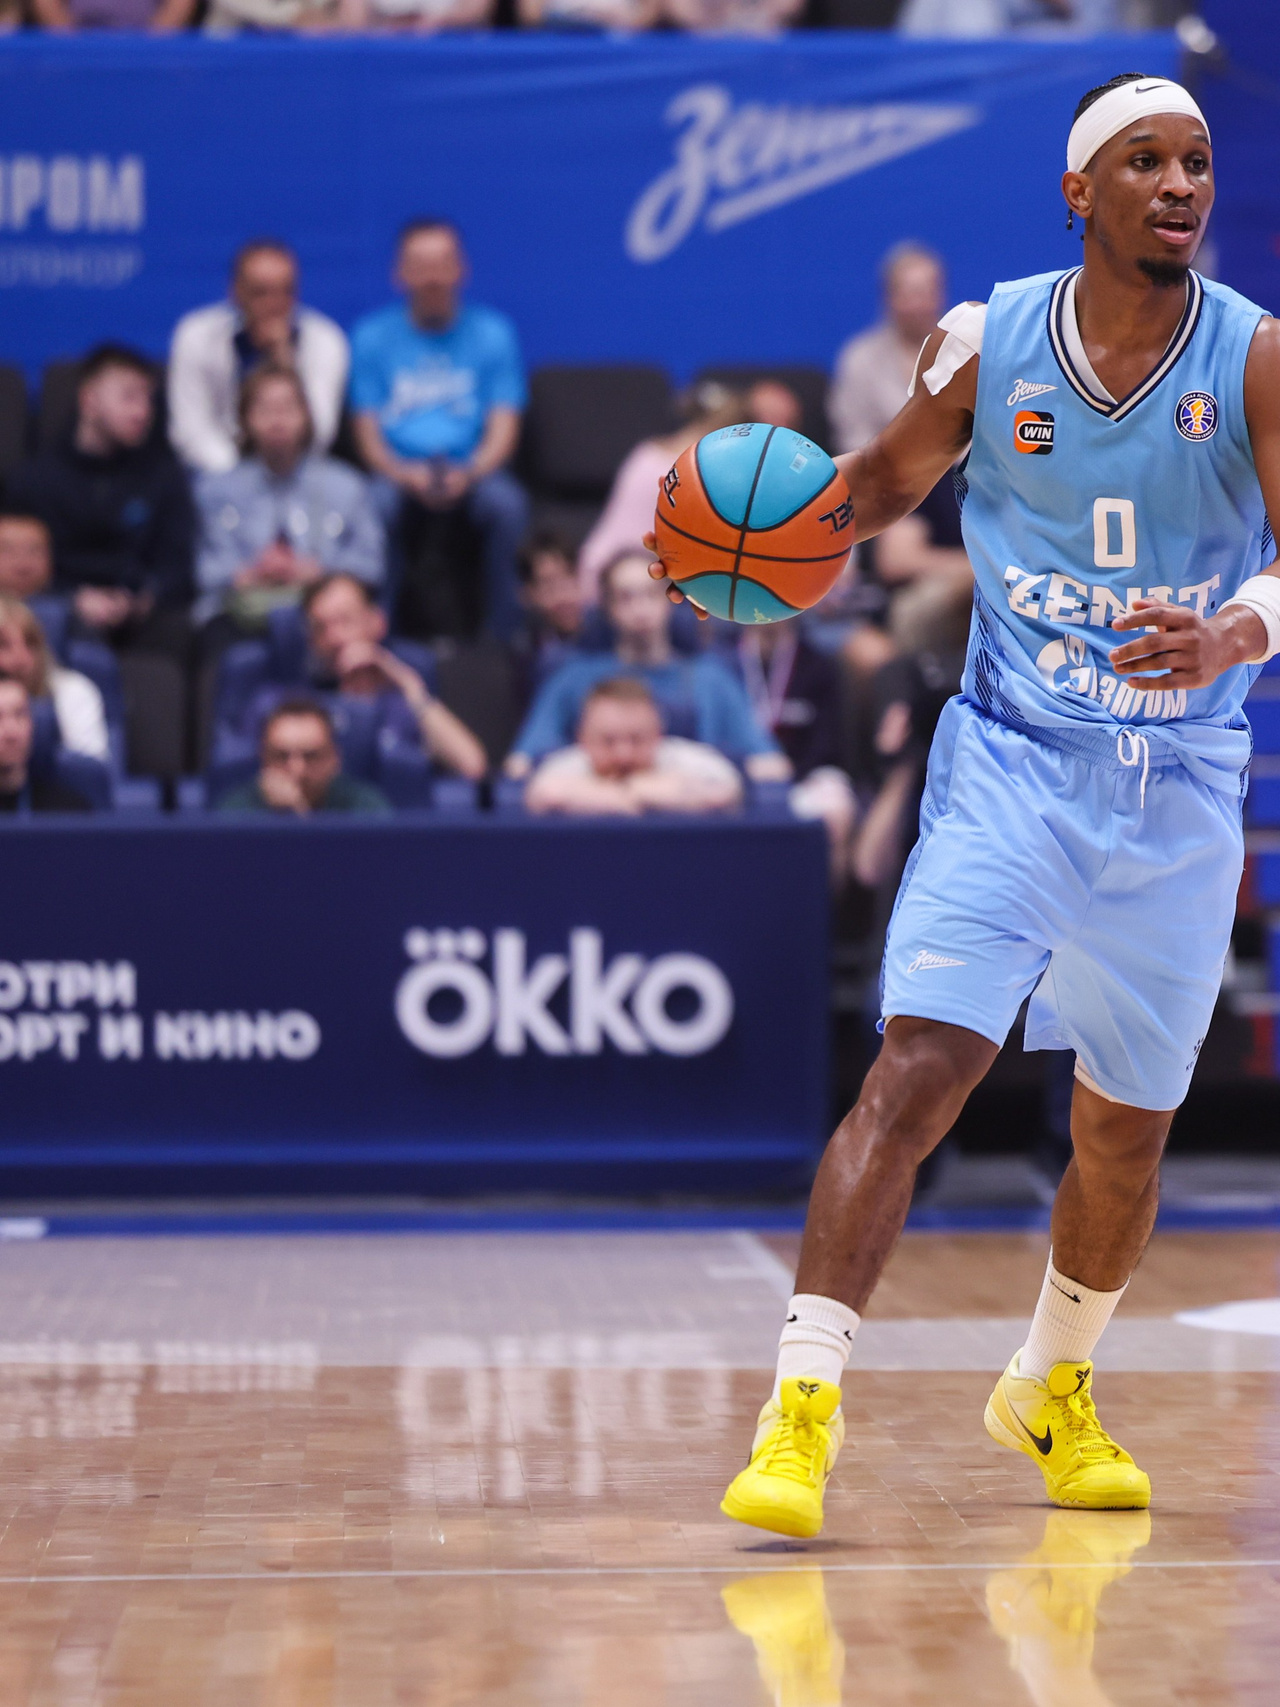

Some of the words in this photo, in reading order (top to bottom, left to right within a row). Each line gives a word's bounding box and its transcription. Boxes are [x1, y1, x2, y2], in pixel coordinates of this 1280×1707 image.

[0, 155, 145, 231] РОМ
[1024, 426, 1052, 440] WIN
[1092, 496, 1137, 568] 0
[1004, 565, 1221, 633] ZENIT
[99, 1011, 143, 1060] И
[155, 1009, 321, 1060] КИНО
